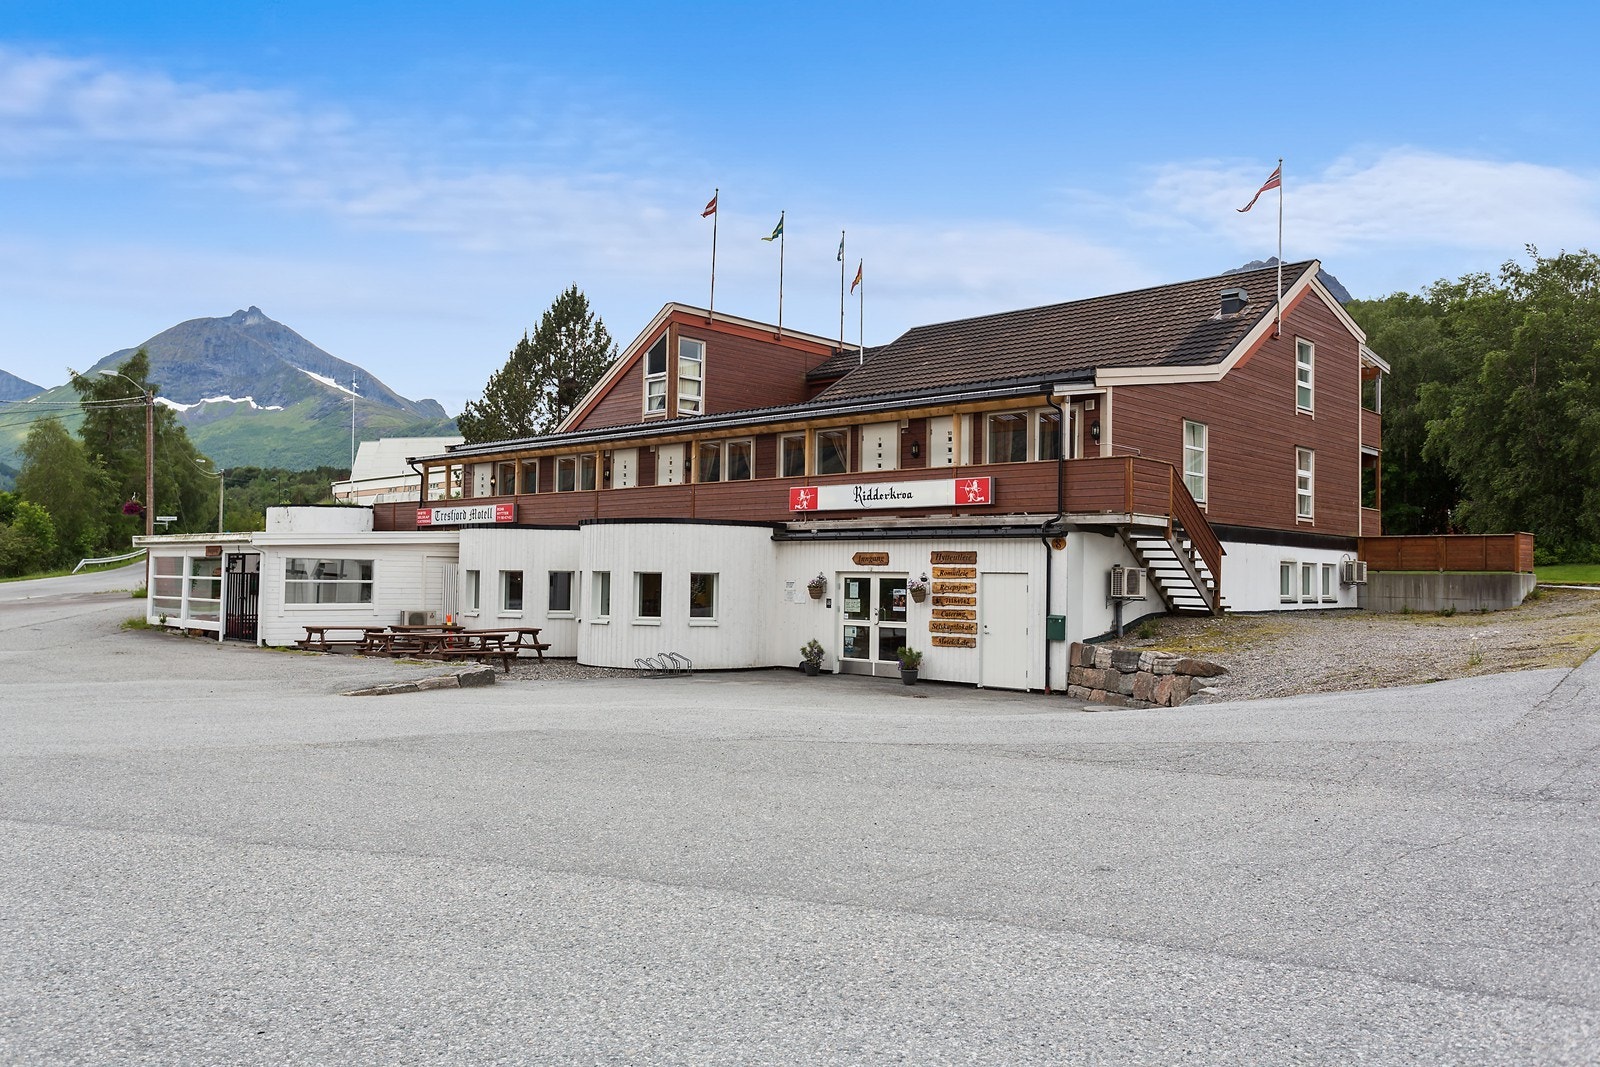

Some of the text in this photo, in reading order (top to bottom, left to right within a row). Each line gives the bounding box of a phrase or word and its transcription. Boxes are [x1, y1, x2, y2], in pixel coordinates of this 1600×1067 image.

[853, 485, 913, 508] Ridderkroa
[434, 508, 493, 522] Tresfjord Motell
